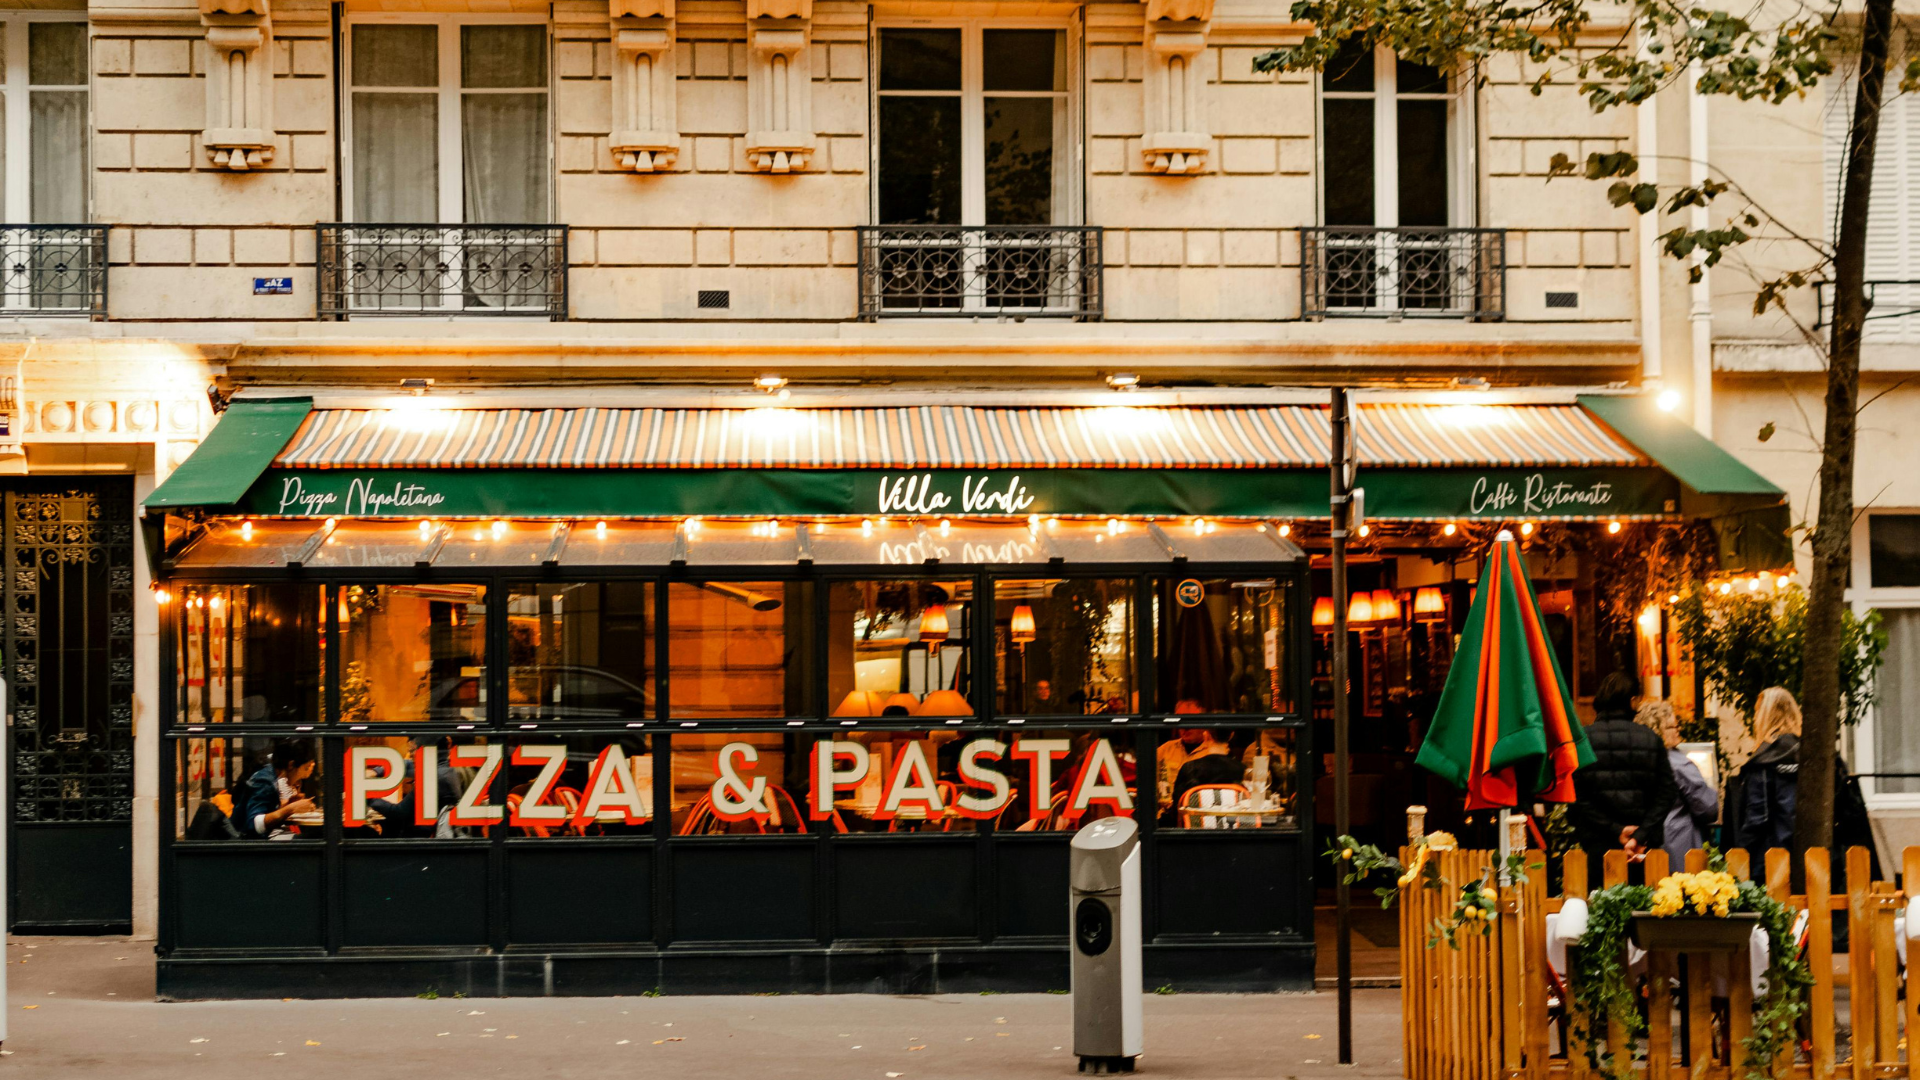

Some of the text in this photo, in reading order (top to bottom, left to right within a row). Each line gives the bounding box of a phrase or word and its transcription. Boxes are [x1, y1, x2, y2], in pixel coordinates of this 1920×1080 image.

[279, 477, 445, 515] Pizza Napoletana
[879, 474, 1035, 514] Villa Verdi
[1524, 473, 1612, 513] Ristorante
[345, 738, 1135, 827] PIZZA & PASTA
